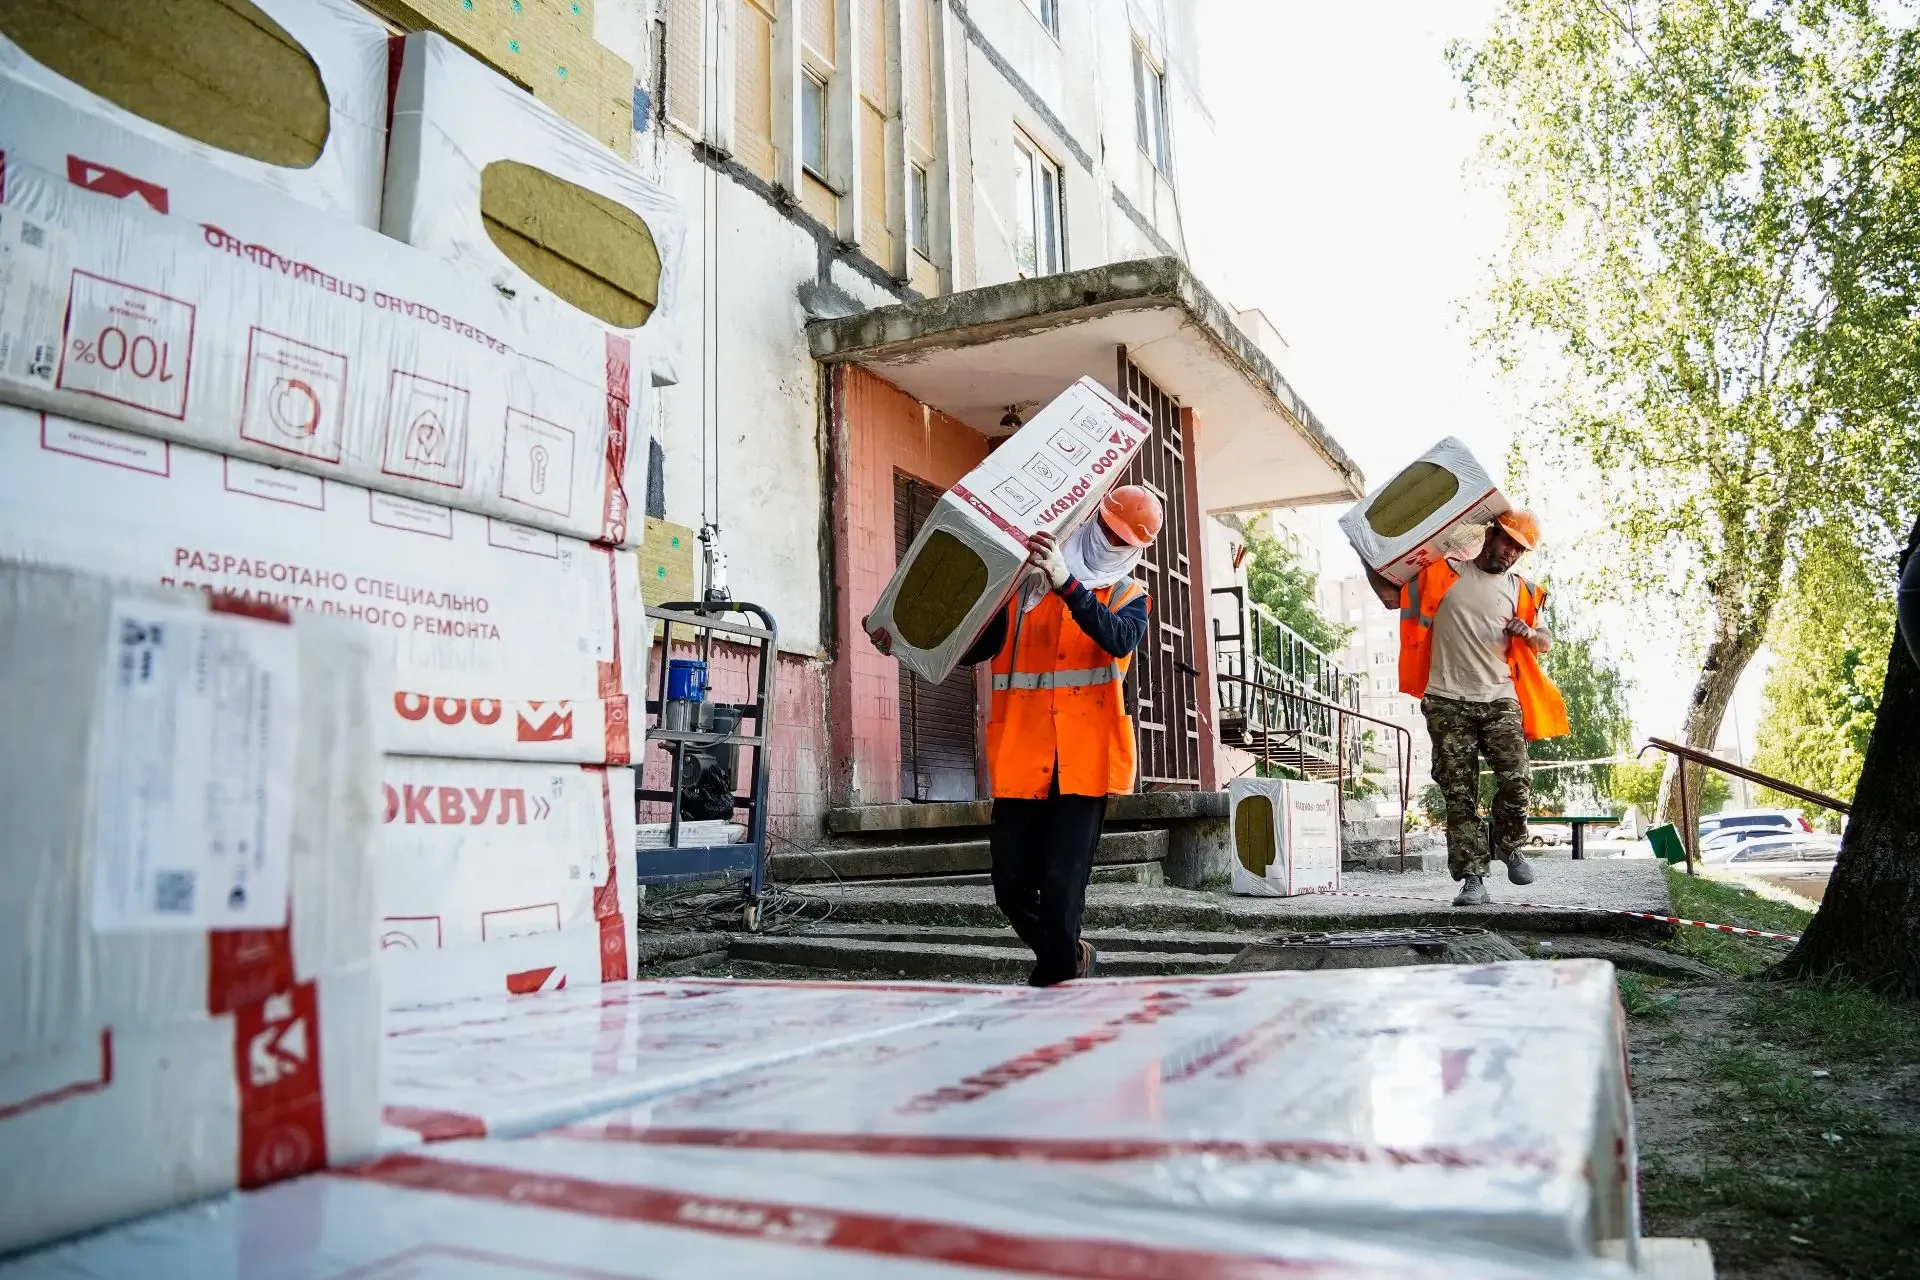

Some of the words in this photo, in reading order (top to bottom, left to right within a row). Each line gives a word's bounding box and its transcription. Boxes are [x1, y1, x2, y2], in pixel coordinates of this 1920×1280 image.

[72, 326, 173, 382] 100%
[1091, 448, 1119, 475] ООО
[1033, 473, 1094, 526] «РОКВУЛ»
[174, 547, 348, 592] РАЗРАБОТАНО
[354, 576, 489, 614] СПЕЦИАЛЬНО
[413, 615, 501, 641] РЕМОНТА
